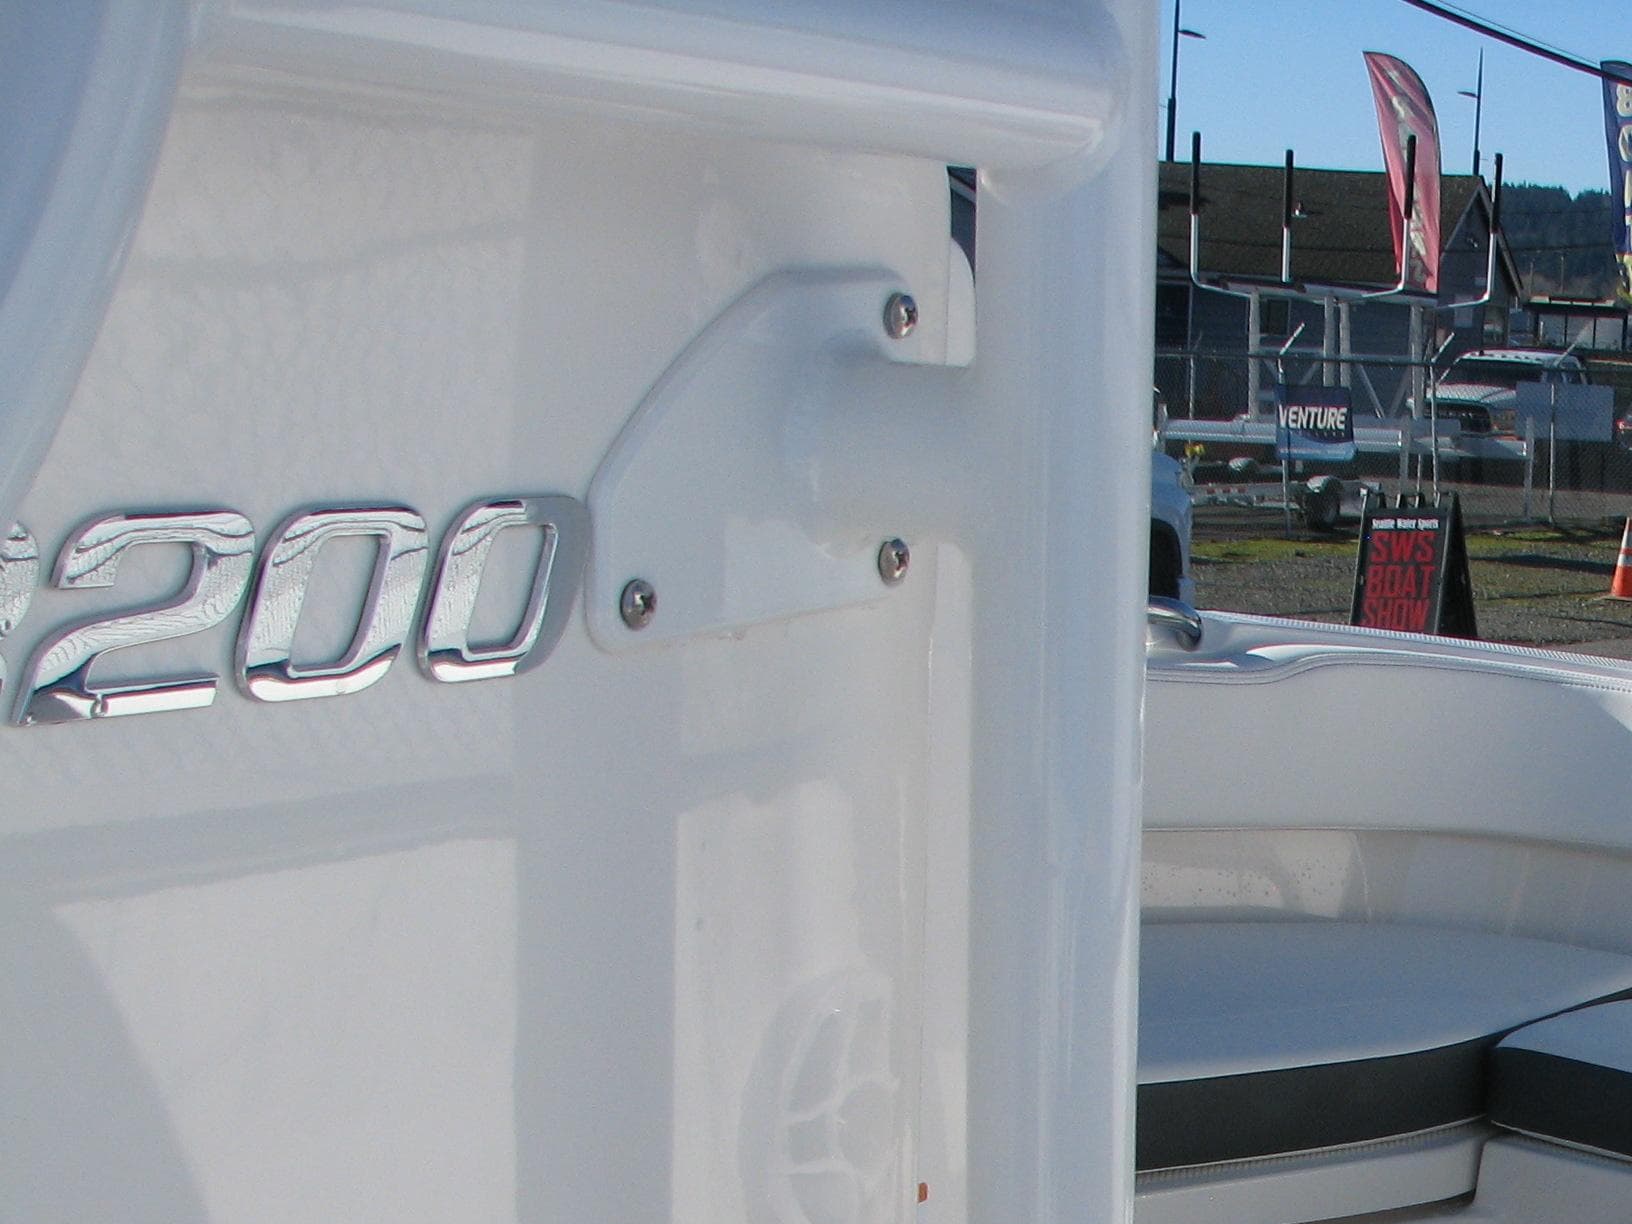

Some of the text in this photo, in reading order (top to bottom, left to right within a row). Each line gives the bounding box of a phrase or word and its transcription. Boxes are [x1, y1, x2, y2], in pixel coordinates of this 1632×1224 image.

[1278, 404, 1348, 430] VENTURE
[1371, 531, 1436, 563] SWS
[1365, 565, 1436, 598] BOAT
[0, 497, 586, 726] 200
[1360, 597, 1431, 631] SHOW
